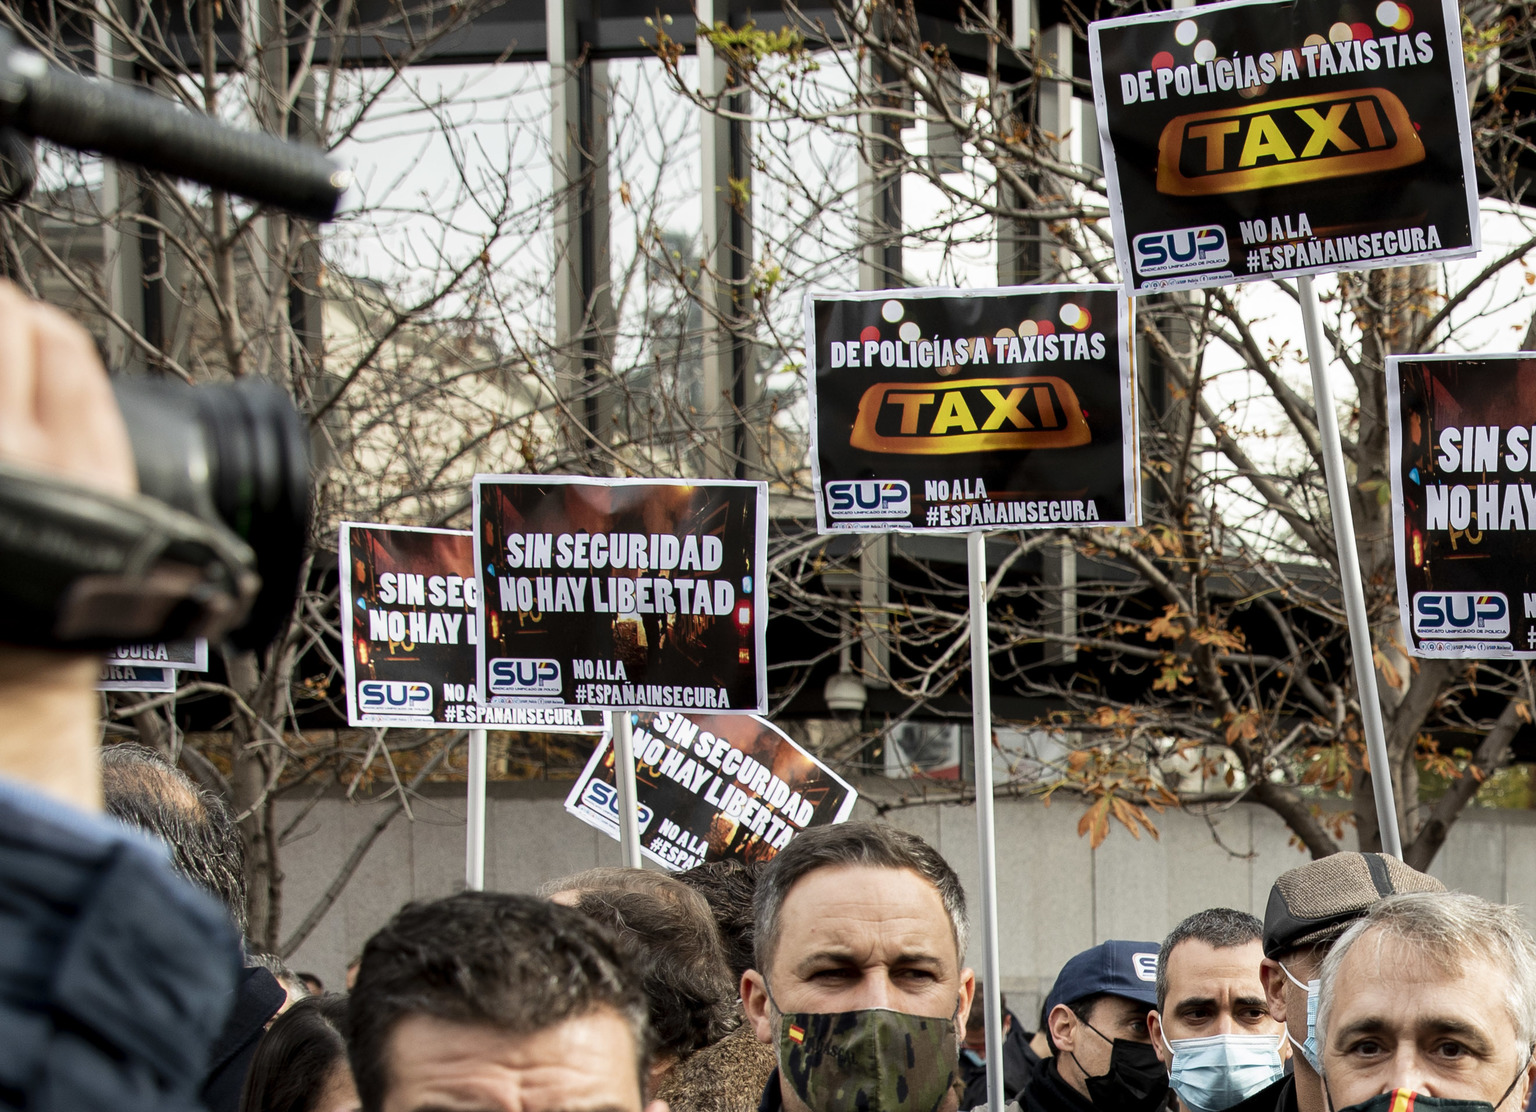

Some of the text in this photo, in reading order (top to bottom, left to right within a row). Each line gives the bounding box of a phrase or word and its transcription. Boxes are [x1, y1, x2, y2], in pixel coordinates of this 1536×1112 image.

[1121, 32, 1433, 105] DE POLICÍAS A TAXISTAS
[1188, 101, 1386, 172] TAXI
[1240, 213, 1313, 245] NO A LA
[1138, 229, 1224, 267] SUP
[1247, 225, 1441, 272] #ESPAÑAINSEGURA
[831, 332, 1105, 368] DE POLICÍAS A TAXISTAS
[887, 387, 1058, 434] TAXI
[1438, 426, 1499, 473] SIN
[829, 484, 907, 509] SUP
[925, 478, 987, 501] NO A LA
[1426, 484, 1470, 530] NO
[926, 499, 1099, 526] #ESPAÑAINSEGURA
[507, 533, 723, 571] SIN SEGURIDAD
[379, 573, 425, 605] SIN
[499, 577, 734, 615] NO HAY LIBERTAD
[369, 609, 406, 642] NO
[410, 612, 462, 644] HAY
[1418, 596, 1506, 627] SUP
[493, 662, 558, 686] SUP
[573, 659, 627, 680] NO A LA
[363, 684, 429, 706] SUP
[444, 684, 465, 702] NO
[576, 681, 730, 708] #ESPAÑAINSEGURA
[653, 711, 814, 828] SIN SEGURIDAD
[633, 728, 799, 851] NO HAY LIBERTA
[658, 818, 709, 858] NO A LA
